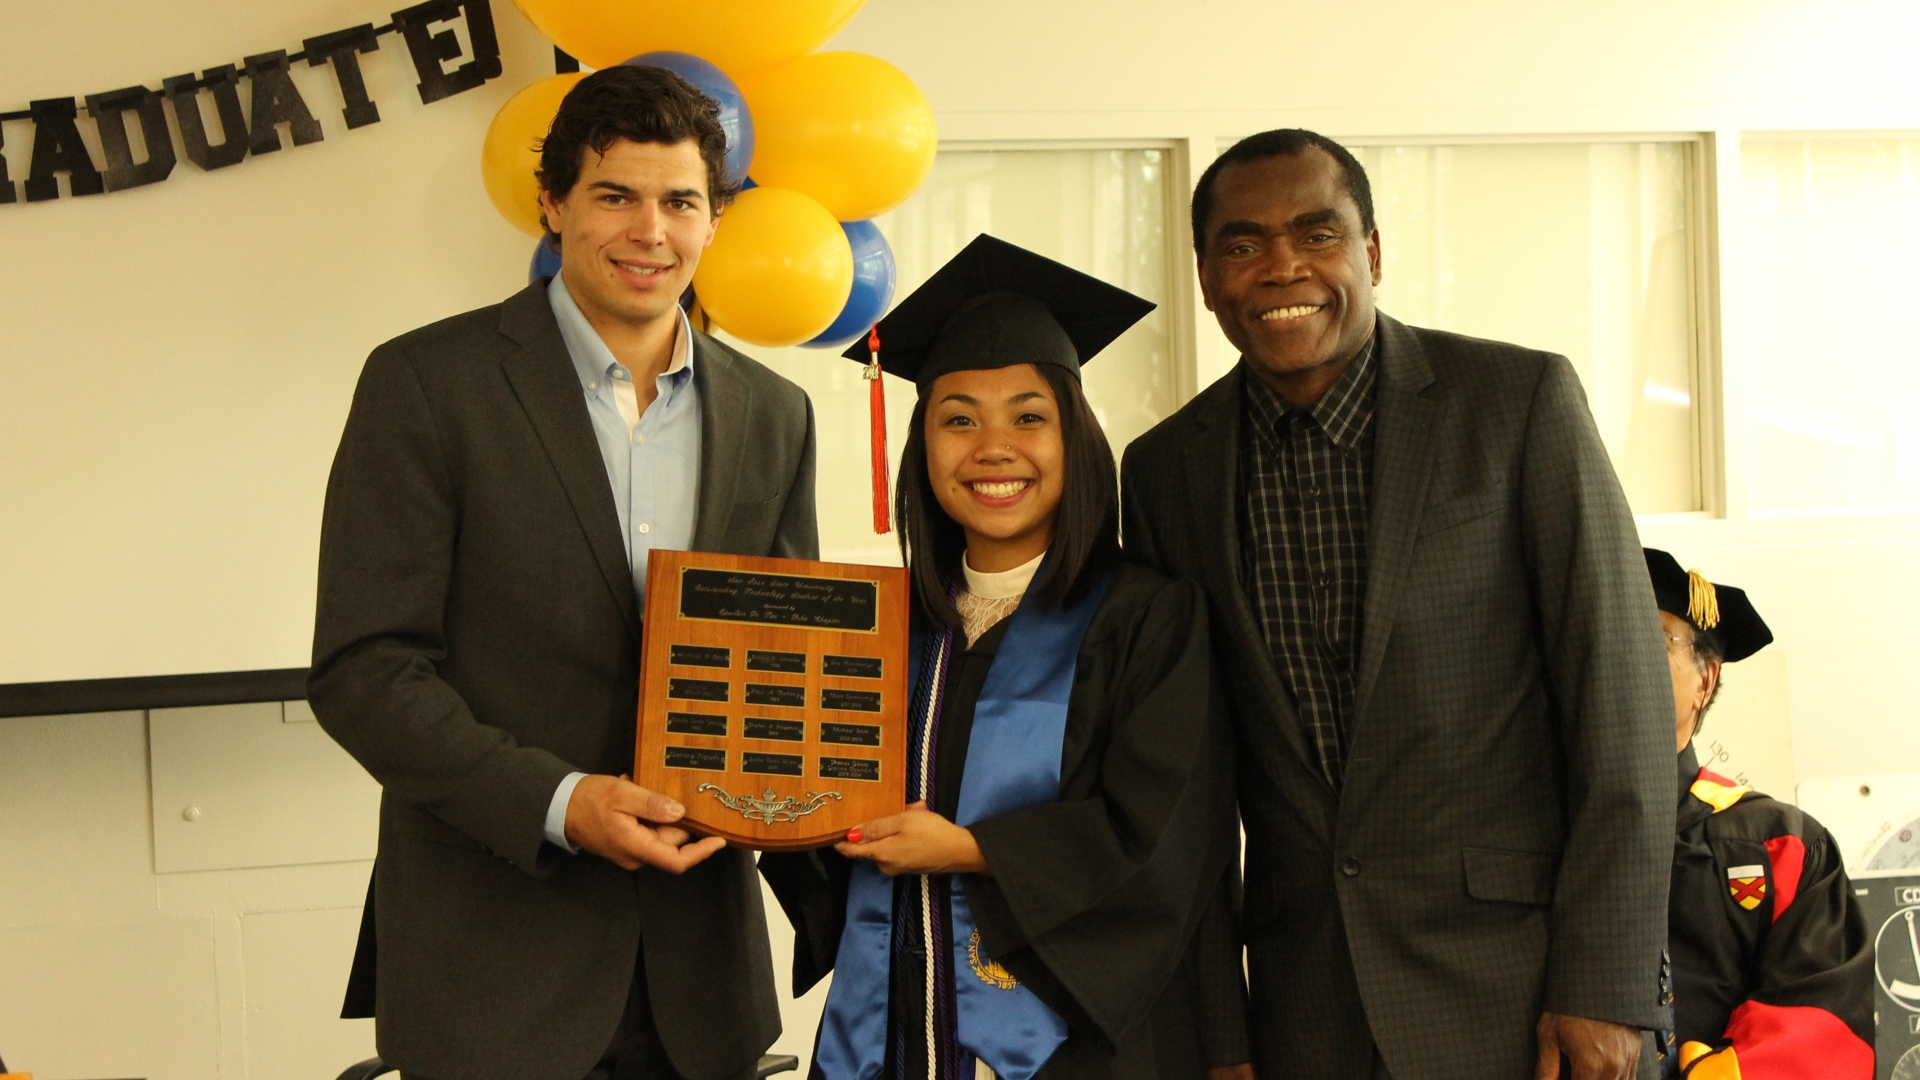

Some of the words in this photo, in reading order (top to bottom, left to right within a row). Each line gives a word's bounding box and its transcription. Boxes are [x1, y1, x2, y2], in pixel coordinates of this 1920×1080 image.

[0, 0, 503, 203] ADUATE!
[694, 584, 738, 596] Outstanding
[743, 589, 785, 600] Technology
[790, 592, 818, 601] Student
[821, 594, 832, 603] of
[832, 595, 844, 603] the
[850, 595, 867, 604] Year
[769, 580, 789, 588] State
[795, 581, 835, 593] University
[719, 608, 747, 618] Epsilon
[814, 615, 841, 624] Chapter
[1709, 740, 1730, 763] 130
[968, 945, 978, 965] SAN
[997, 980, 1017, 990] 1857
